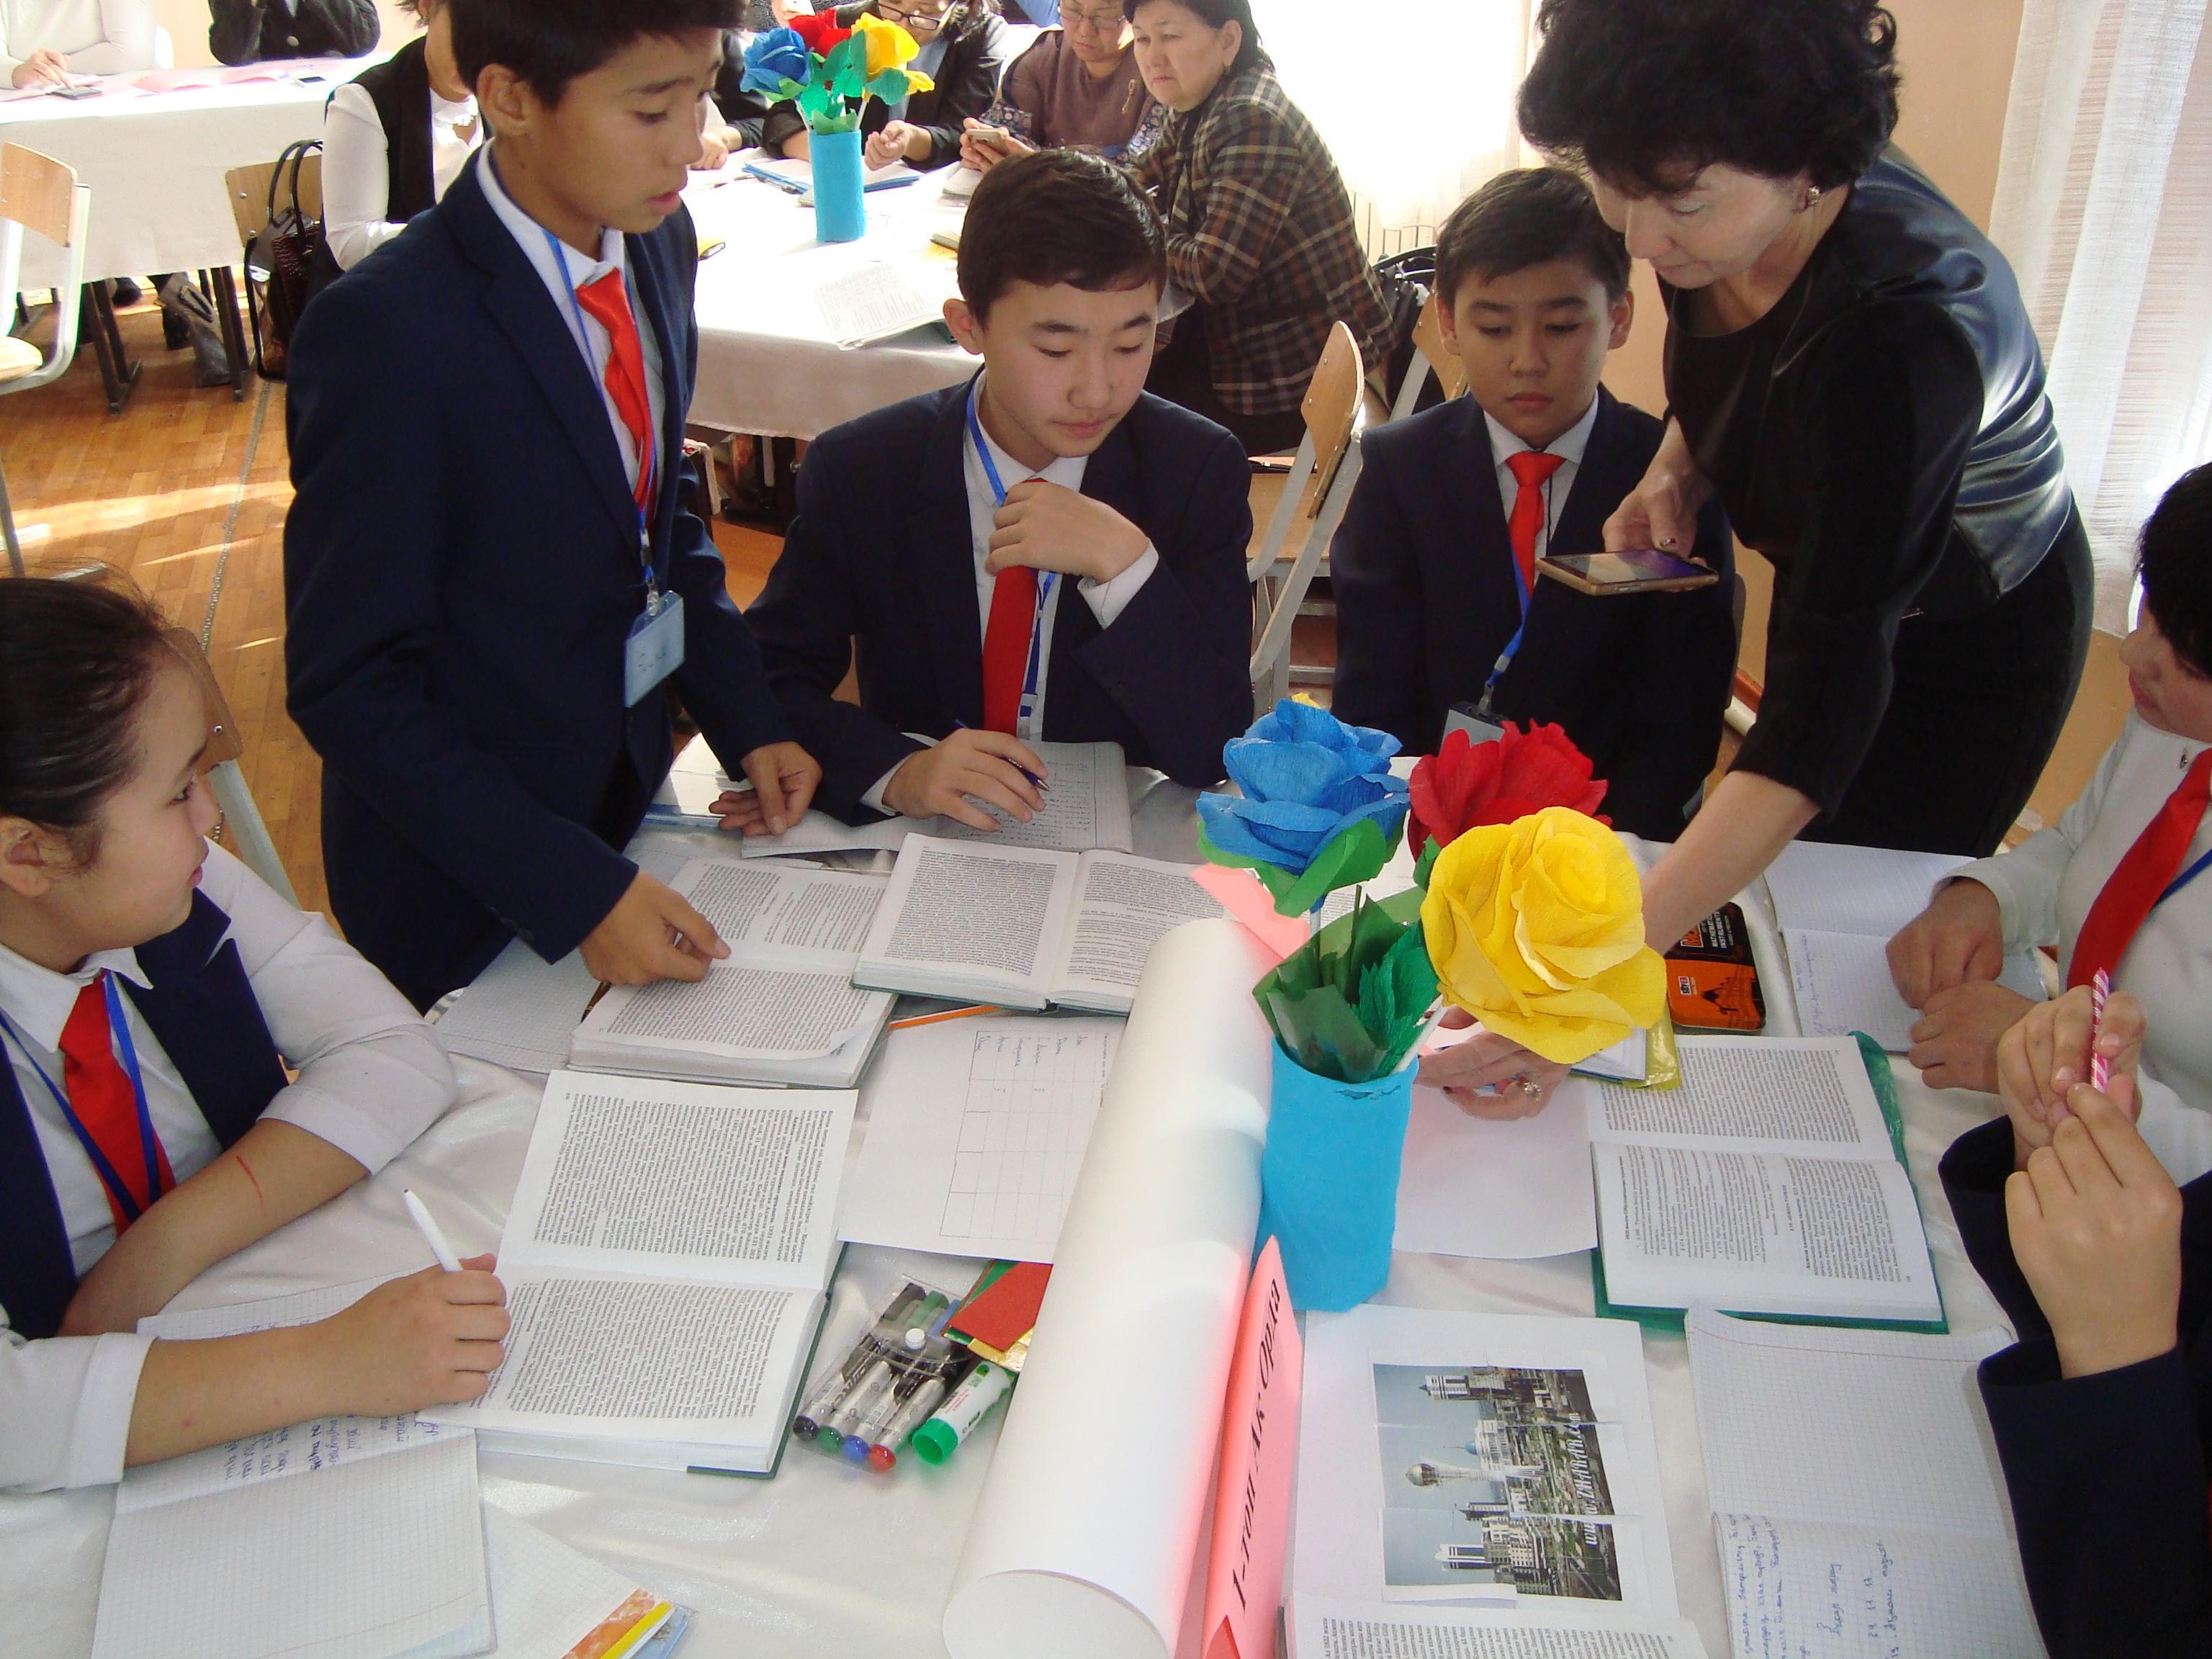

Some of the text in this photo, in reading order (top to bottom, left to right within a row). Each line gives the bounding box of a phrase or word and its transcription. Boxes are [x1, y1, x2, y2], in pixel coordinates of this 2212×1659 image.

[1232, 1473, 1256, 1614] 1-топ
[1259, 1278, 1280, 1390] Орда
[1566, 1412, 1599, 1546] www.ZHARAR.cm
